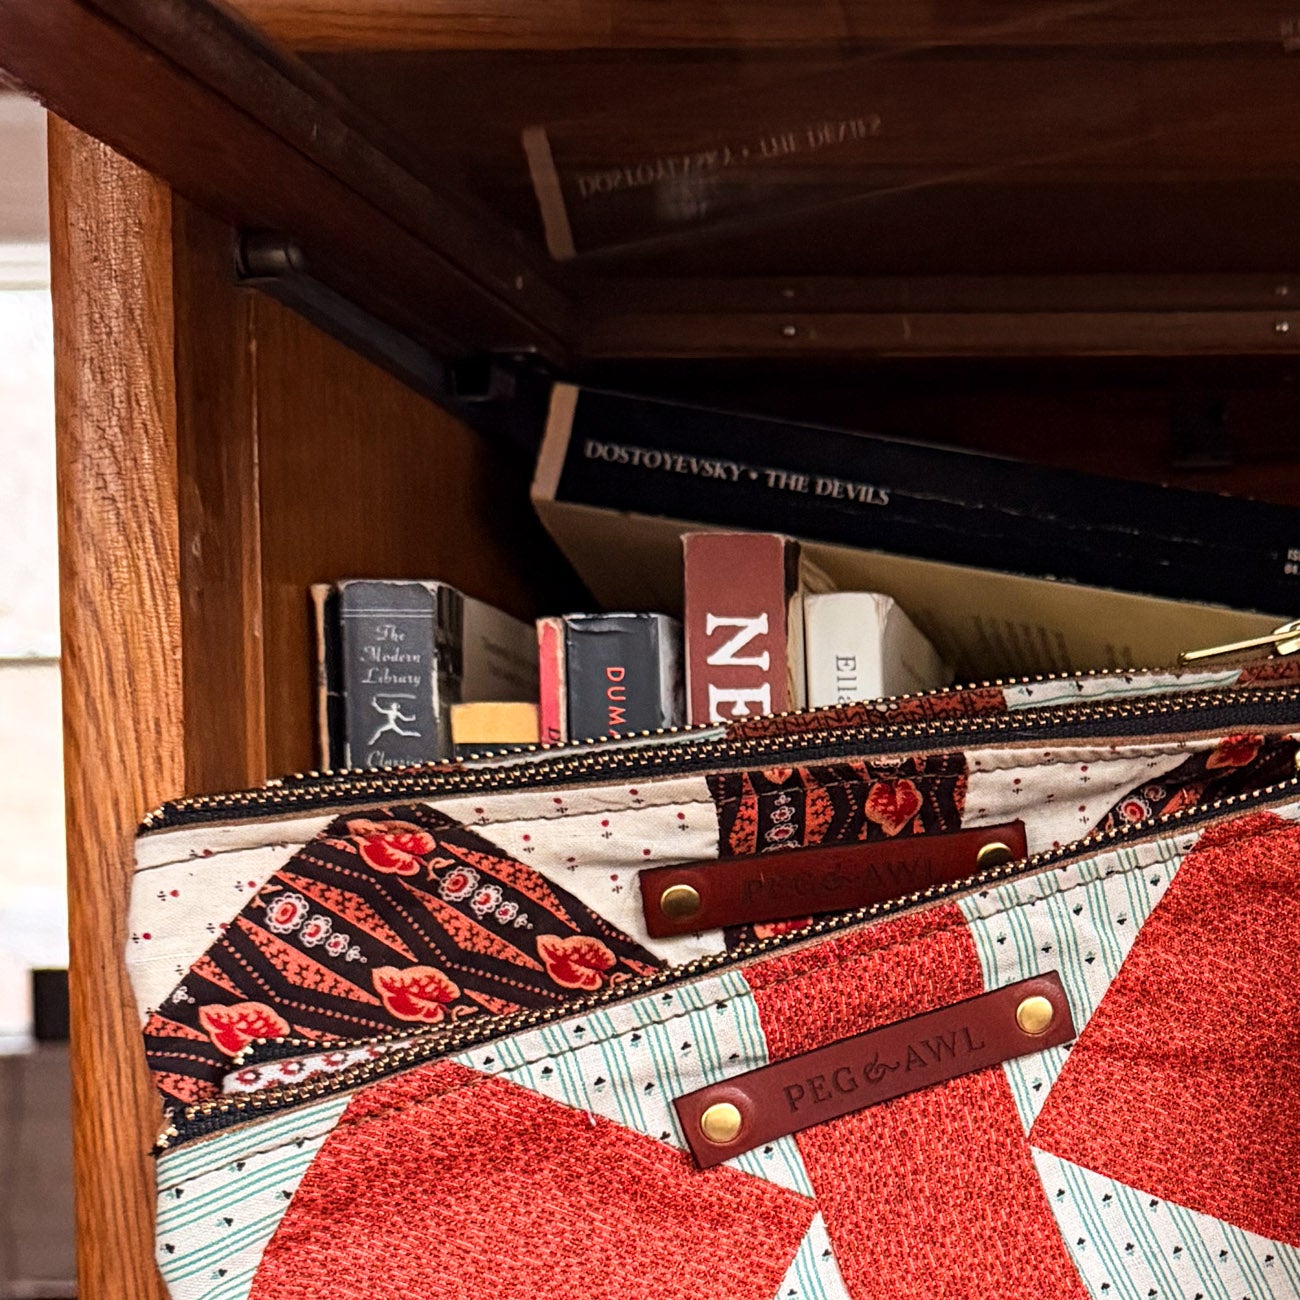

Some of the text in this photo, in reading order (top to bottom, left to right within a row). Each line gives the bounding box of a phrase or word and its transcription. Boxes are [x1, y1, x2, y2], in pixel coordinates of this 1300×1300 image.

[584, 439, 889, 505] DOSTOYEVSKY THE DEVILS
[376, 624, 406, 641] The
[360, 646, 421, 663] Modern
[361, 667, 421, 688] Library
